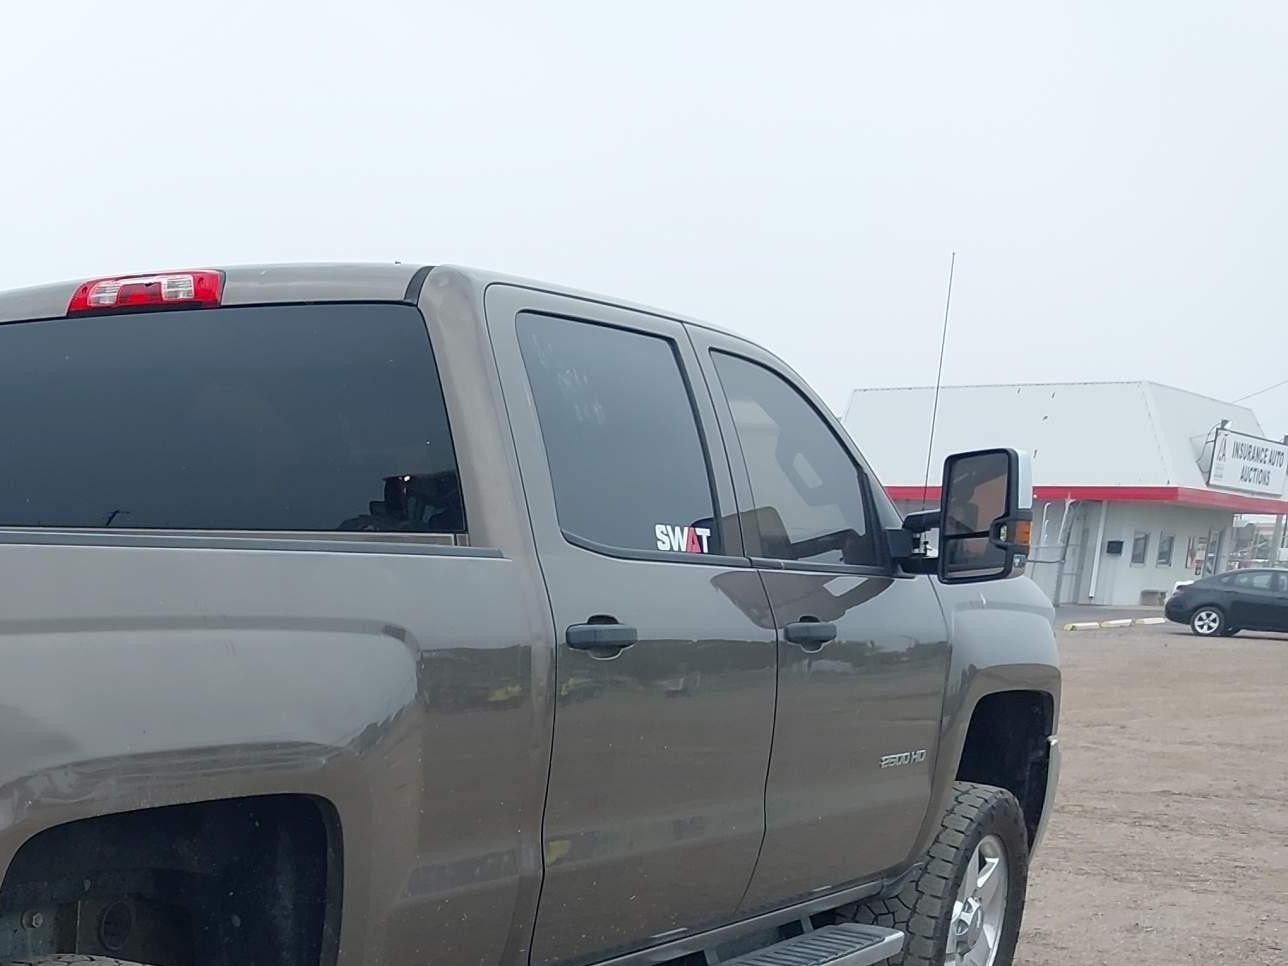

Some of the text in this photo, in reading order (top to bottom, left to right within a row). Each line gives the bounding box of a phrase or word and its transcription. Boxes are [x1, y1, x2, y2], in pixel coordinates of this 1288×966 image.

[1232, 441, 1268, 465] INSURANCE
[1268, 450, 1285, 468] AUTO
[1240, 466, 1271, 486] AUCTIONS
[655, 524, 711, 553] SWAT
